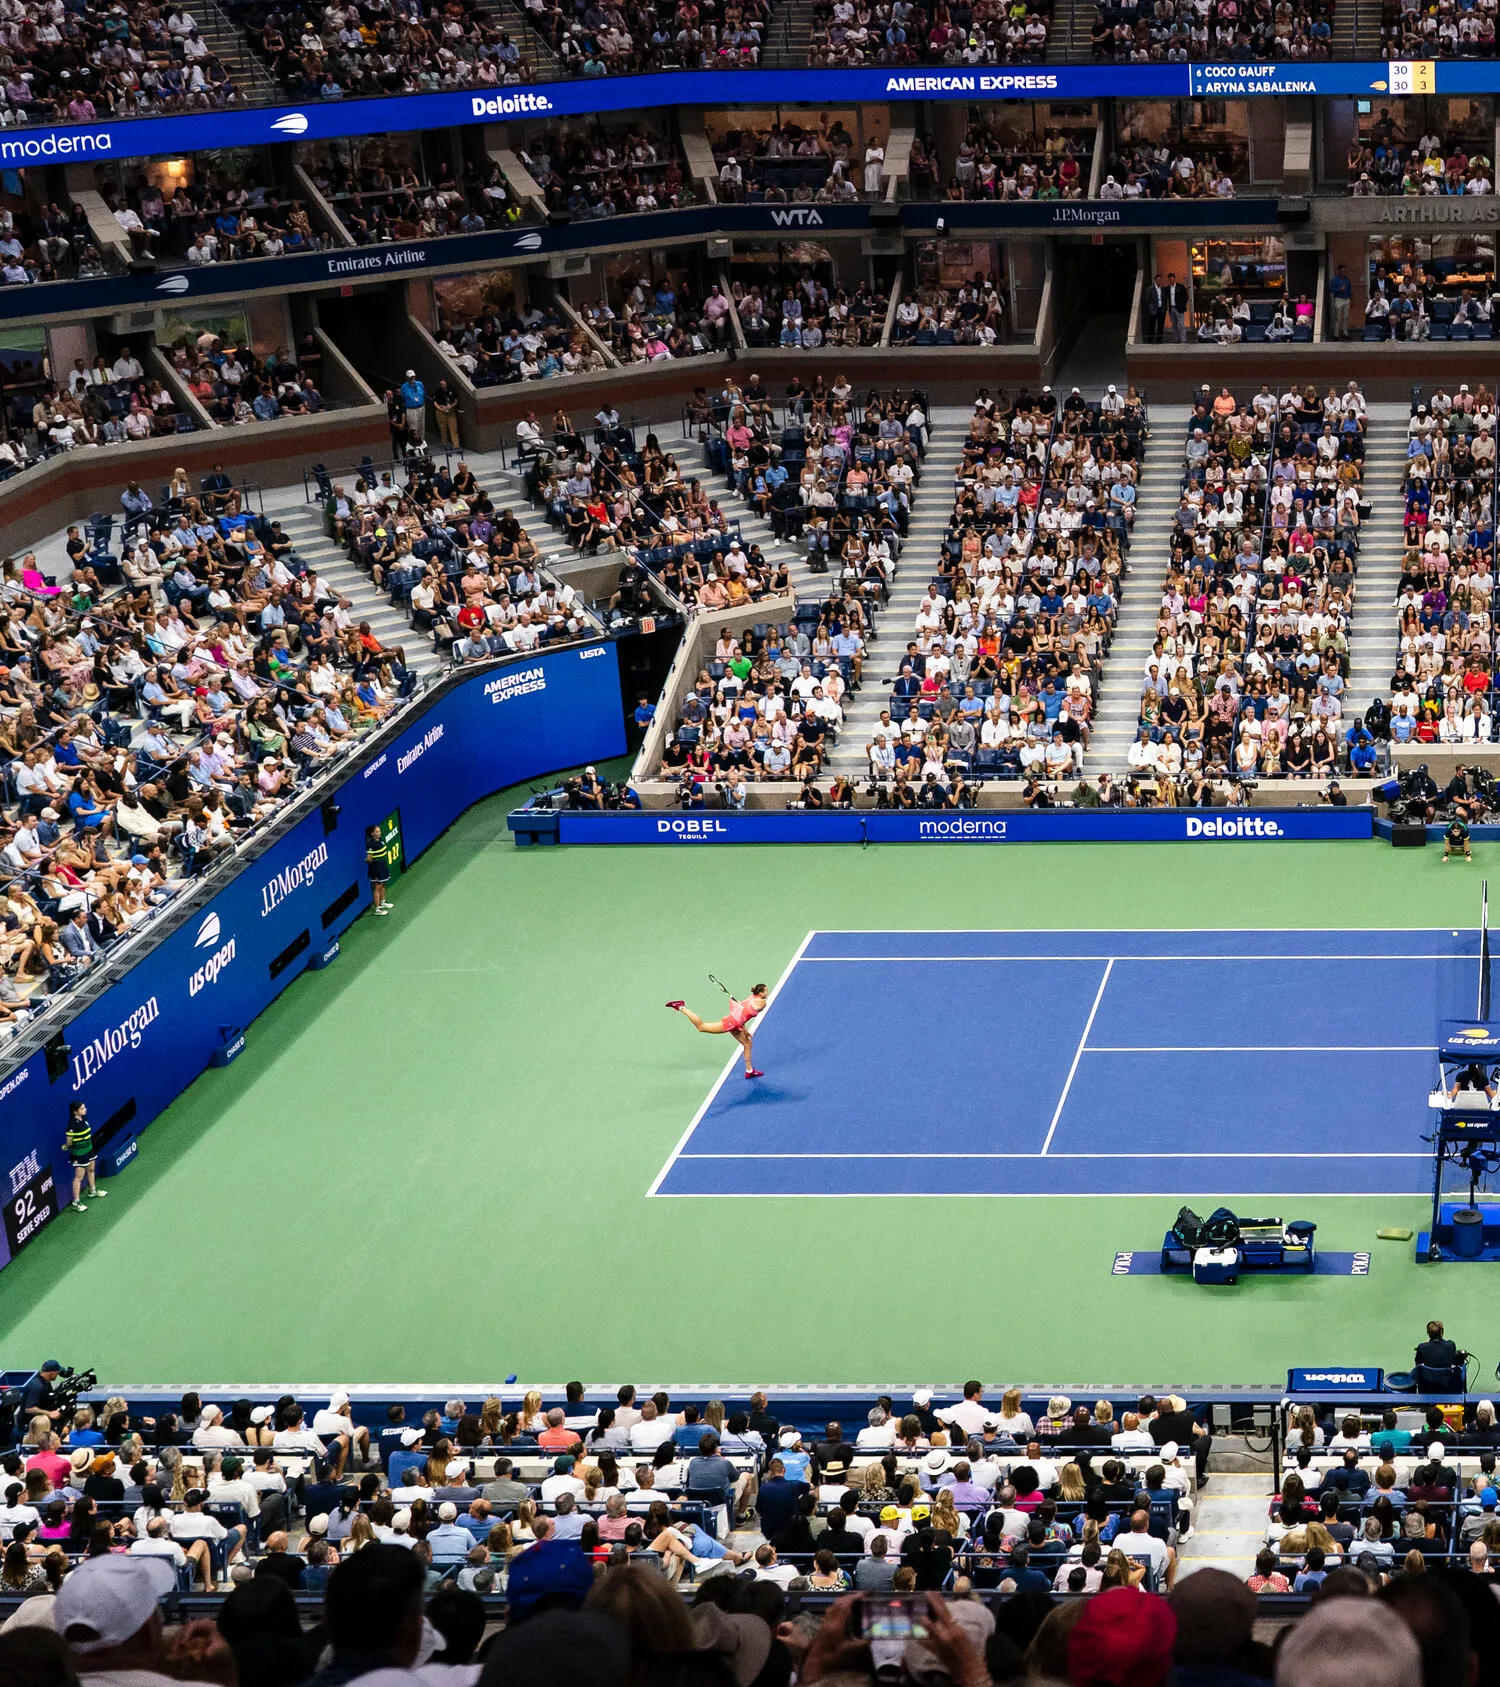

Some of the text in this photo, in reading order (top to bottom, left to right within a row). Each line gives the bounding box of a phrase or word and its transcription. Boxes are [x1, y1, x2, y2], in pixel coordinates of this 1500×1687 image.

[1205, 66, 1234, 77] COCO
[1239, 66, 1275, 77] GAUFF
[1394, 66, 1407, 75] 30
[1420, 66, 1427, 75] 2
[886, 75, 1058, 91] AMERICAN EXPRESS
[1196, 81, 1427, 93] 2 ARYNA SABALENKA 30 3
[472, 93, 553, 116] Deloitte.
[2, 132, 112, 159] moderna
[770, 208, 824, 226] WTA
[1053, 208, 1120, 225] J.P.Morgan
[1379, 207, 1463, 222] ARTHUR
[328, 248, 426, 273] Emirates Airline
[579, 647, 606, 659] USTA
[483, 667, 545, 695] AMERICAN
[491, 679, 547, 704] EXPRESS
[397, 724, 444, 774] Emirates Airline
[657, 820, 727, 833] DOBEL
[919, 820, 1007, 834] moderna
[1186, 816, 1284, 837] Deloitte.
[261, 842, 328, 917] J.P.Morgan
[189, 938, 235, 997] us open
[72, 996, 160, 1091] J.P.Morgan
[227, 1041, 241, 1059] CHASE
[1447, 1037, 1500, 1046] us open
[116, 1147, 133, 1167] CHASE
[9, 1149, 41, 1195] IBM
[15, 1190, 36, 1225] 92
[17, 1205, 51, 1244] SERVE SPEED
[1113, 1252, 1133, 1275] POLO
[1352, 1253, 1370, 1275] POLO
[1303, 1373, 1366, 1384] Wilson
